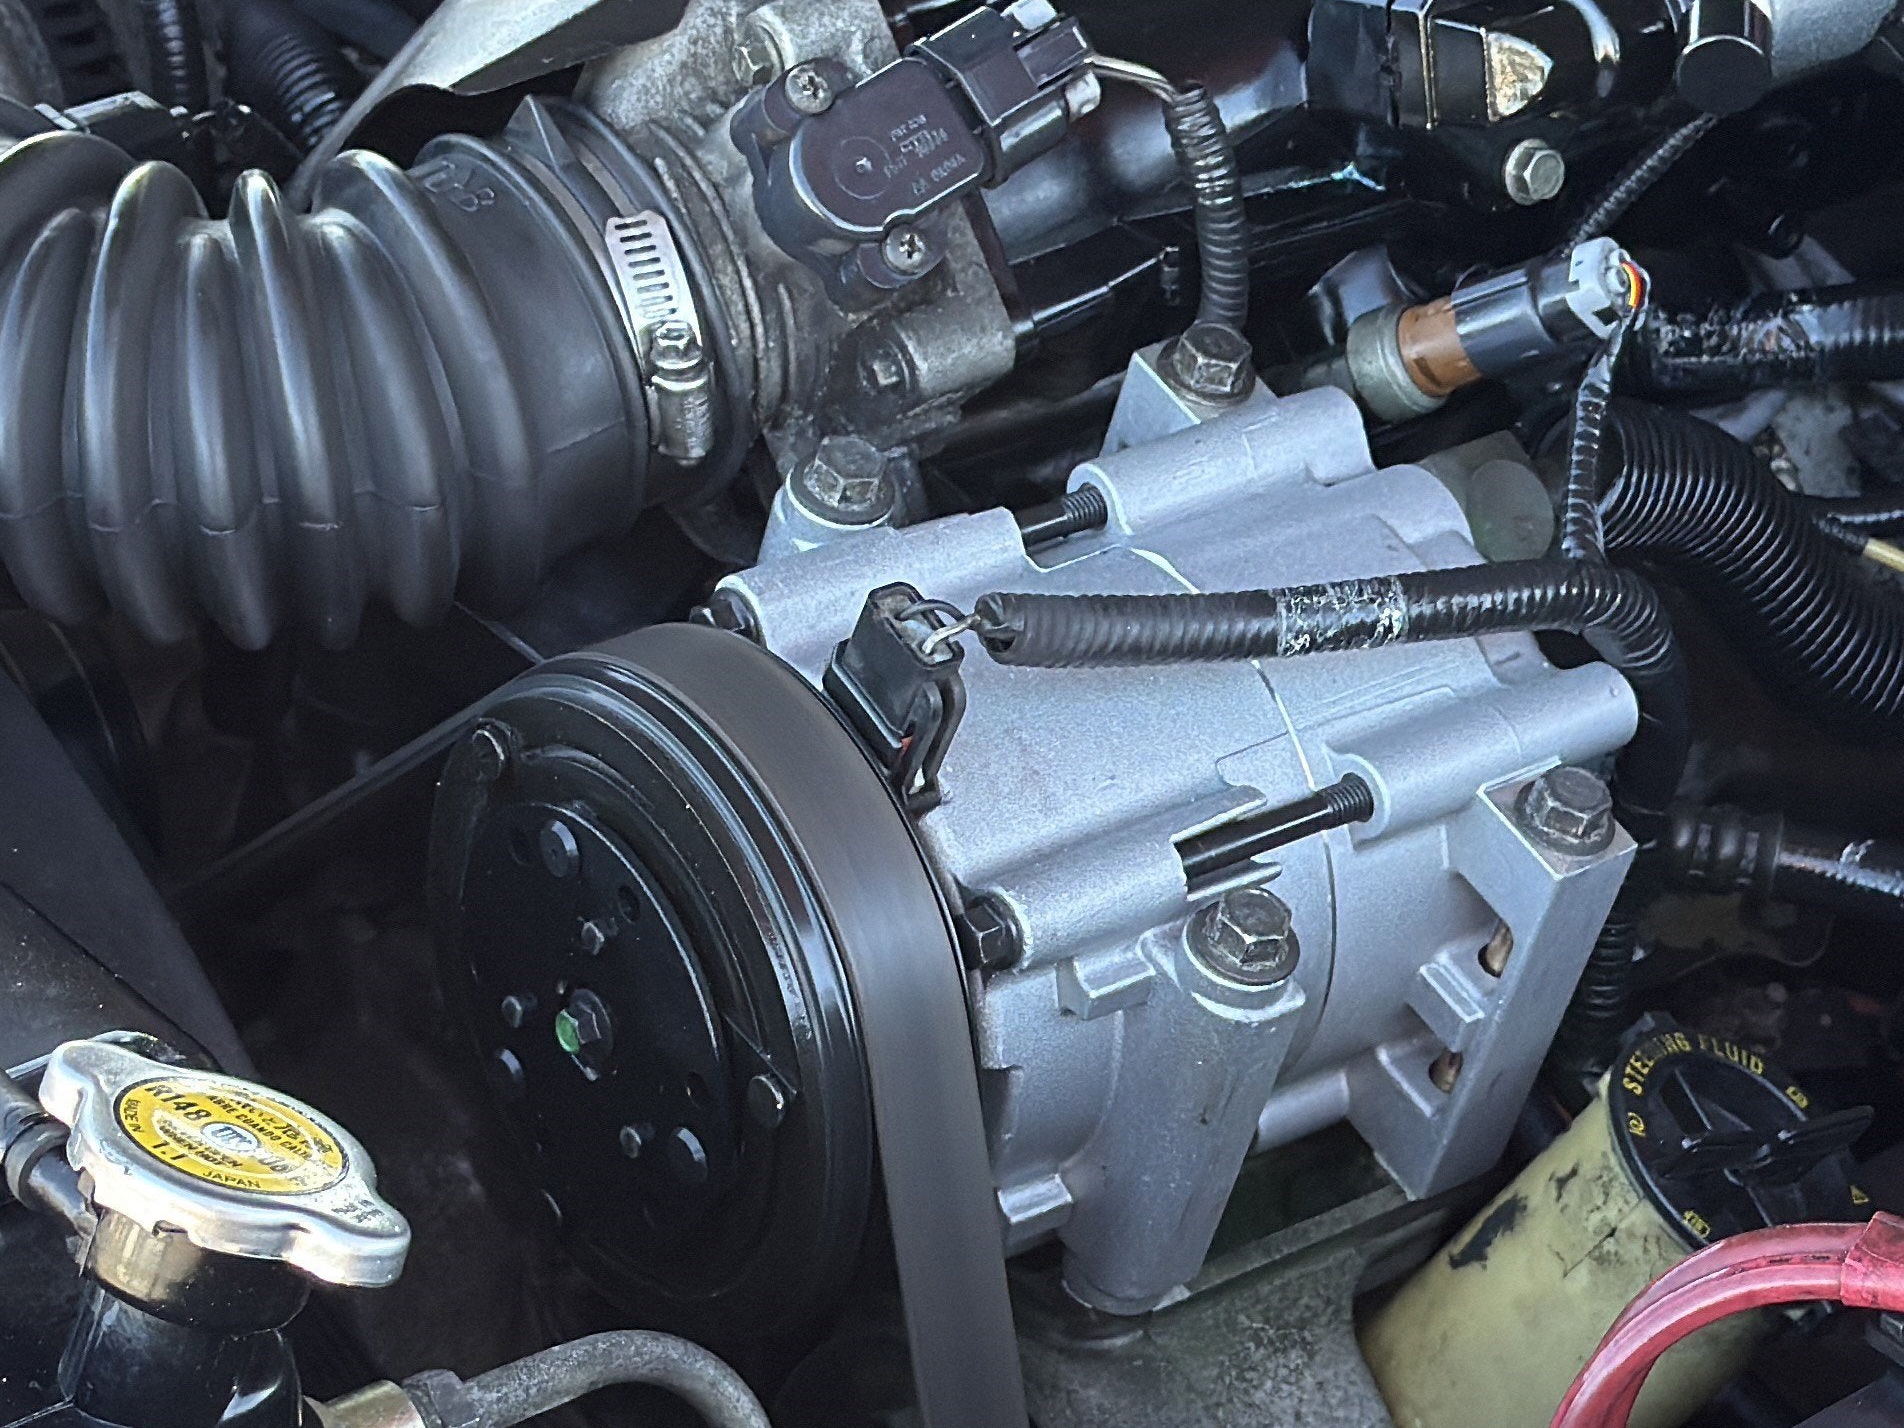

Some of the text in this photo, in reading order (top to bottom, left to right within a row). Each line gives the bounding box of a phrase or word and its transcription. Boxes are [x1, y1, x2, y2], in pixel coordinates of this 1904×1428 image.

[1699, 1035, 1765, 1076] FLUID
[145, 1084, 213, 1122] R148
[203, 1170, 261, 1189] JAPAN
